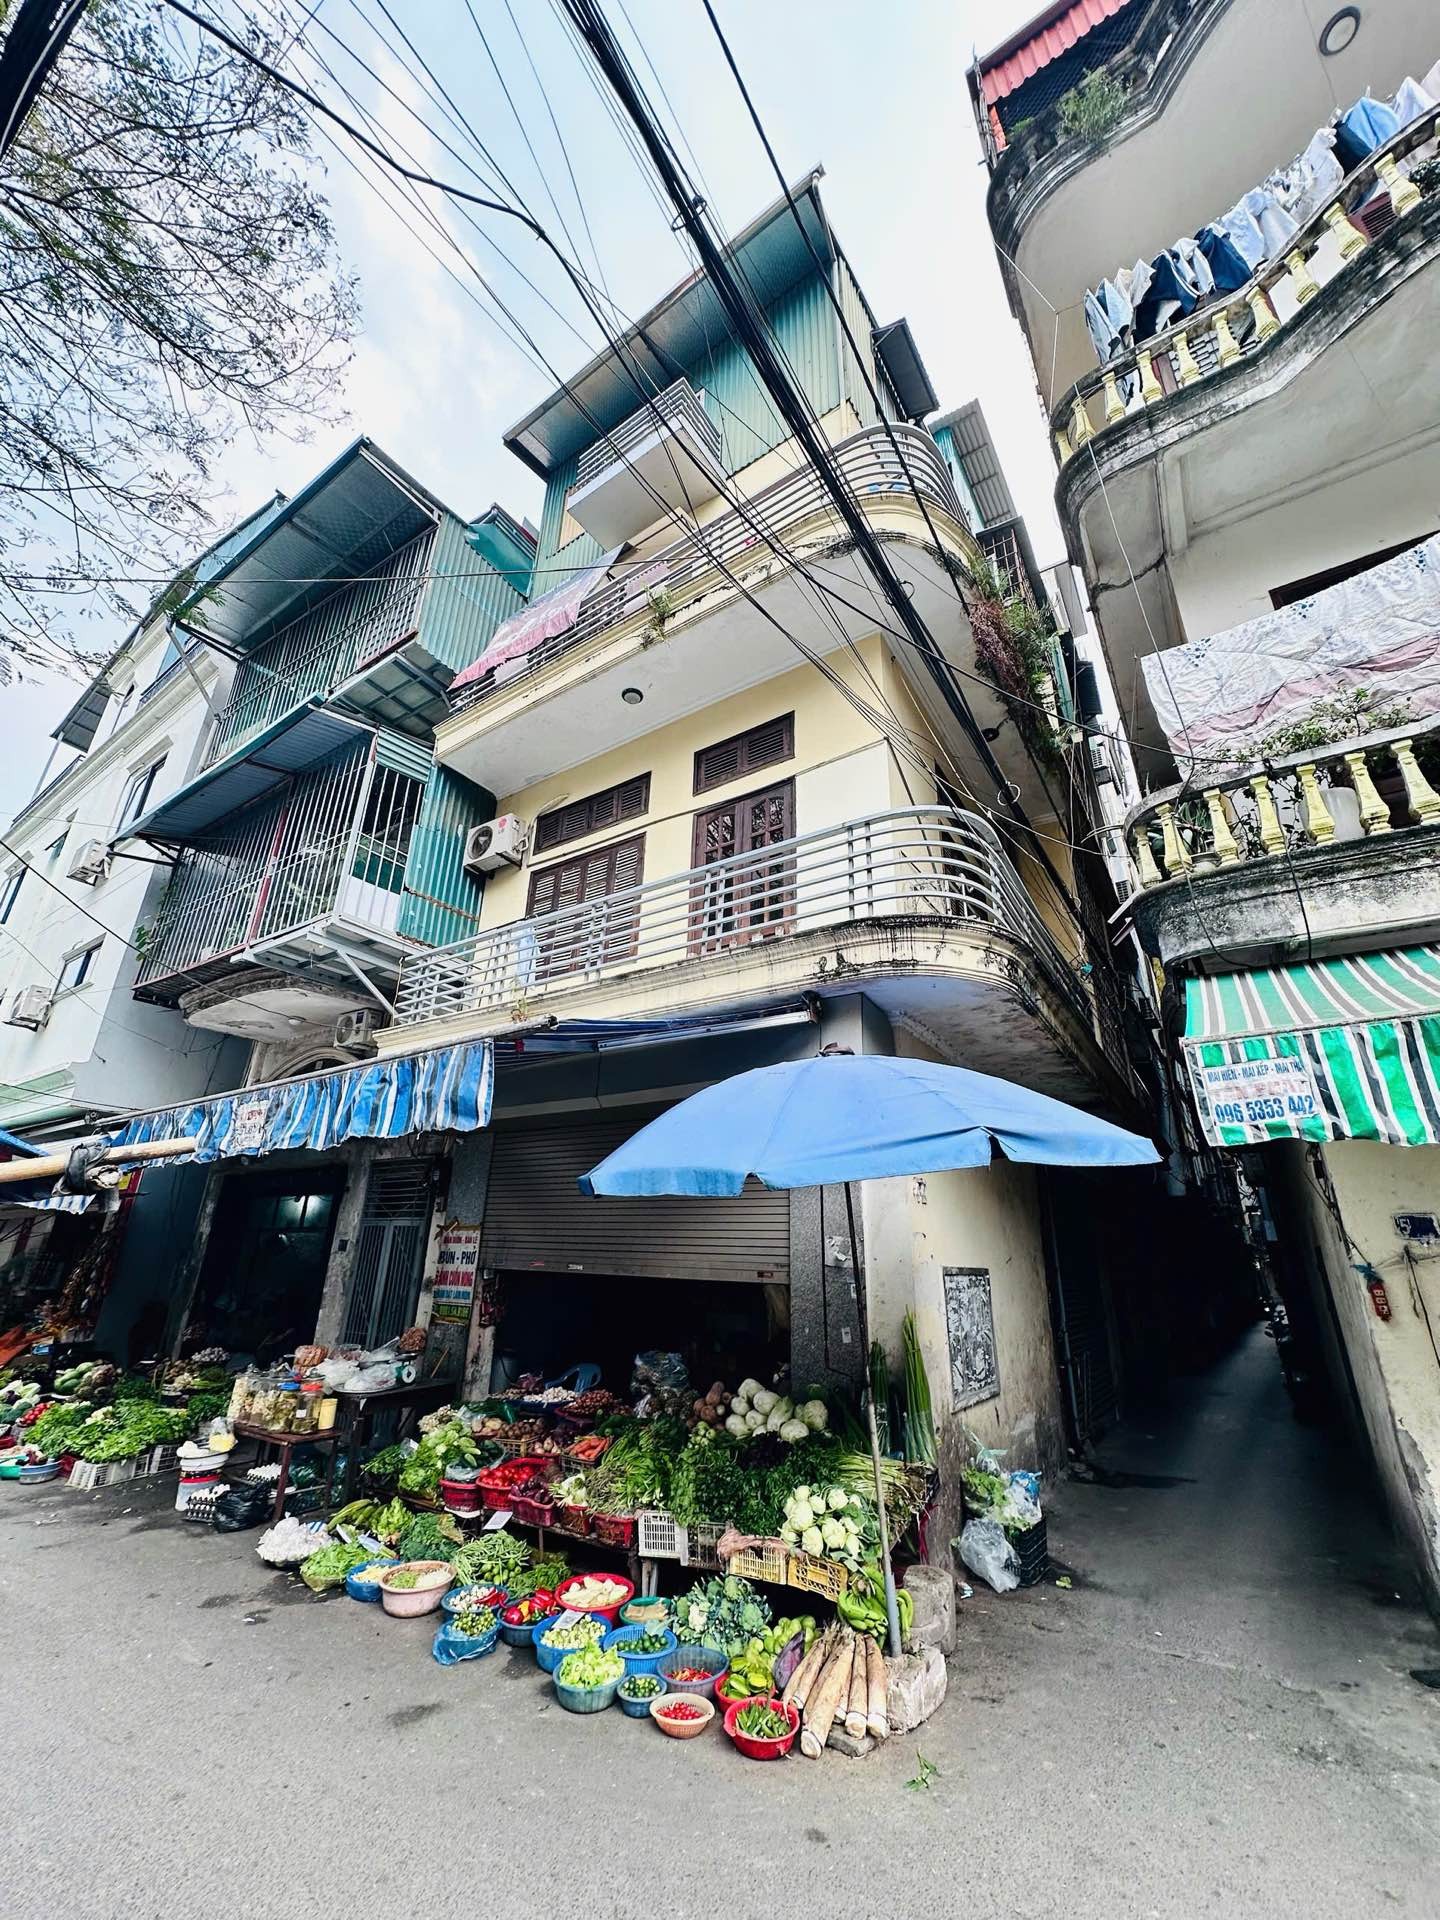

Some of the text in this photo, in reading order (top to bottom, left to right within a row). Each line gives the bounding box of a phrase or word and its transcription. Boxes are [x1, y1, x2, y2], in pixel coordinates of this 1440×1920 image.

[1214, 1094, 1314, 1123] 096 5353 442
[461, 1245, 477, 1264] PHỞ
